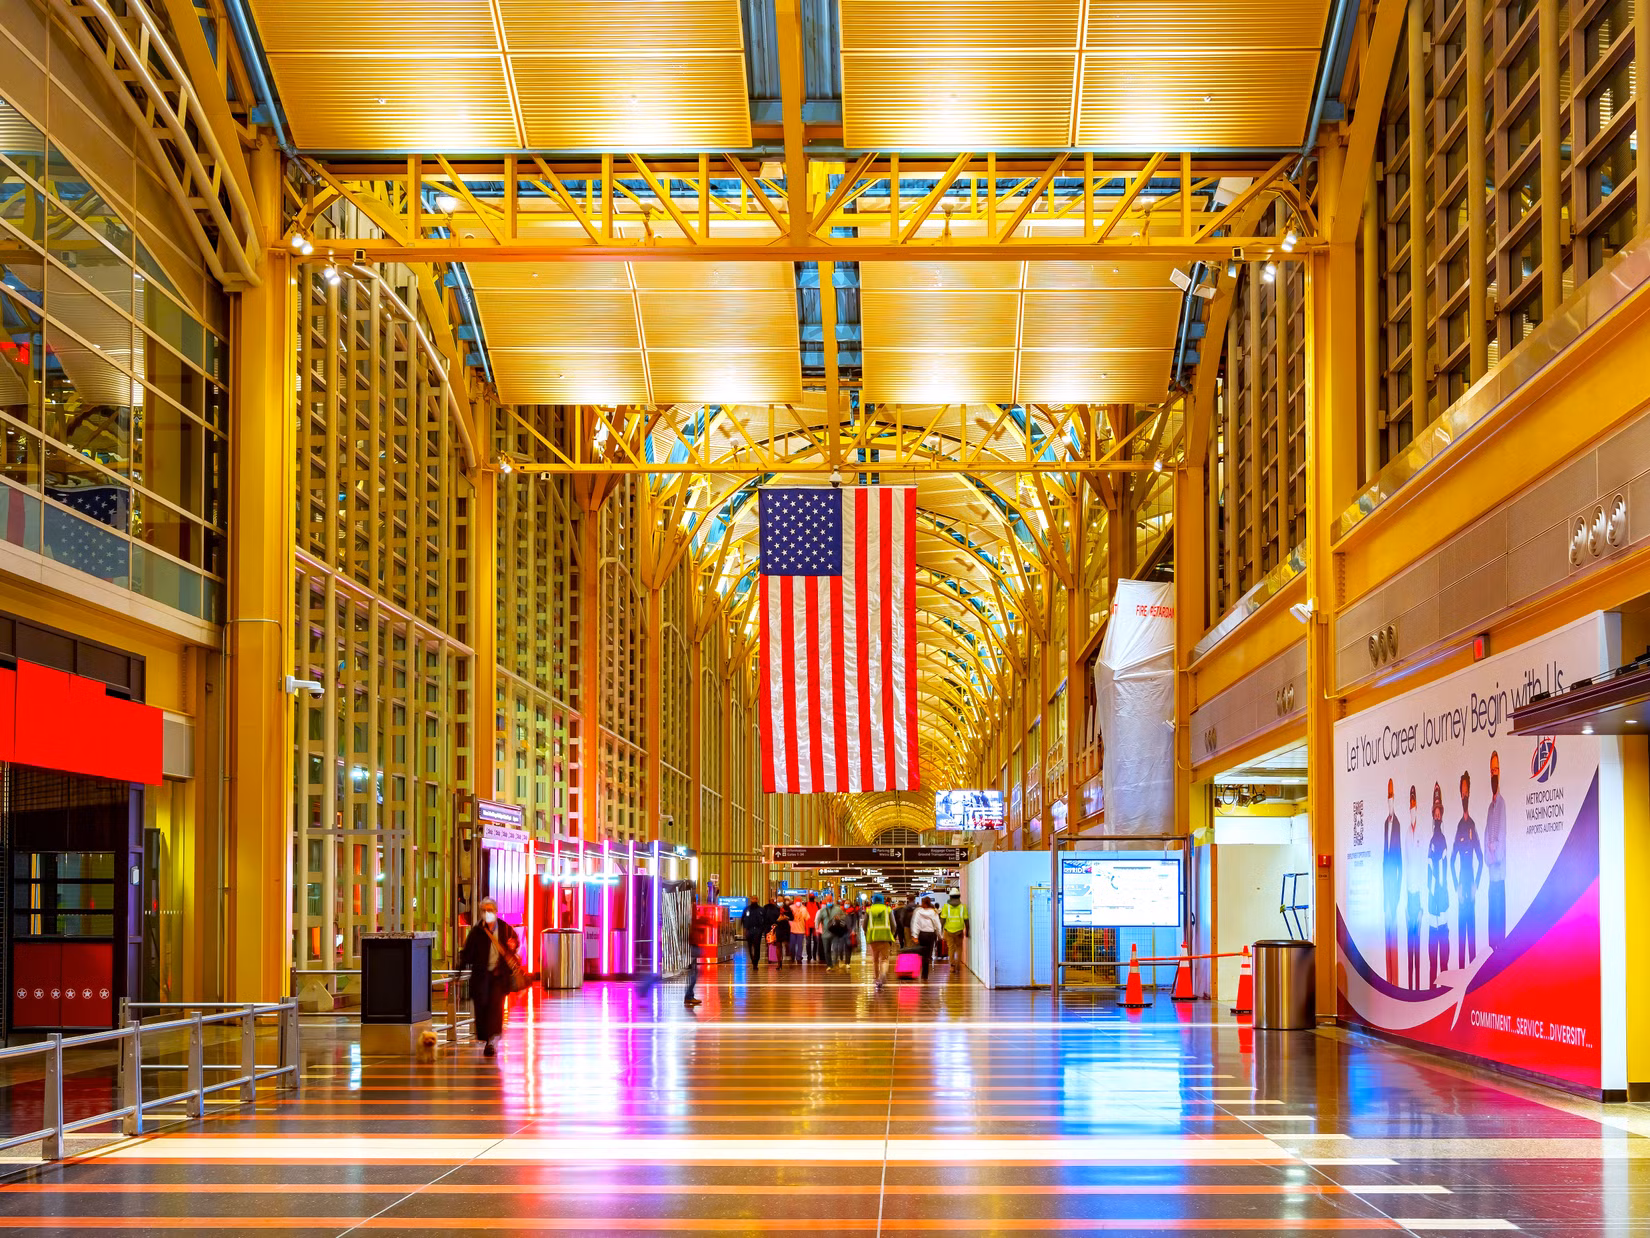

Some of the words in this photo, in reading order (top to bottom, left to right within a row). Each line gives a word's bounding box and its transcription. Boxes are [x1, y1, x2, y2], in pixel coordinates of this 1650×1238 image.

[1136, 605, 1148, 617] FIRE
[1346, 737, 1360, 772] Let
[1360, 733, 1382, 768] Your
[1382, 722, 1419, 761] Career
[1420, 704, 1469, 750] Journey
[1470, 681, 1508, 738] Begin
[1510, 668, 1542, 709] with
[1546, 660, 1564, 698] Us
[1525, 786, 1564, 806] METROPOLITAN
[1525, 803, 1565, 821] WASHINGTON
[1525, 823, 1543, 835] AIRPORTS
[1543, 821, 1564, 833] AUTHORITY
